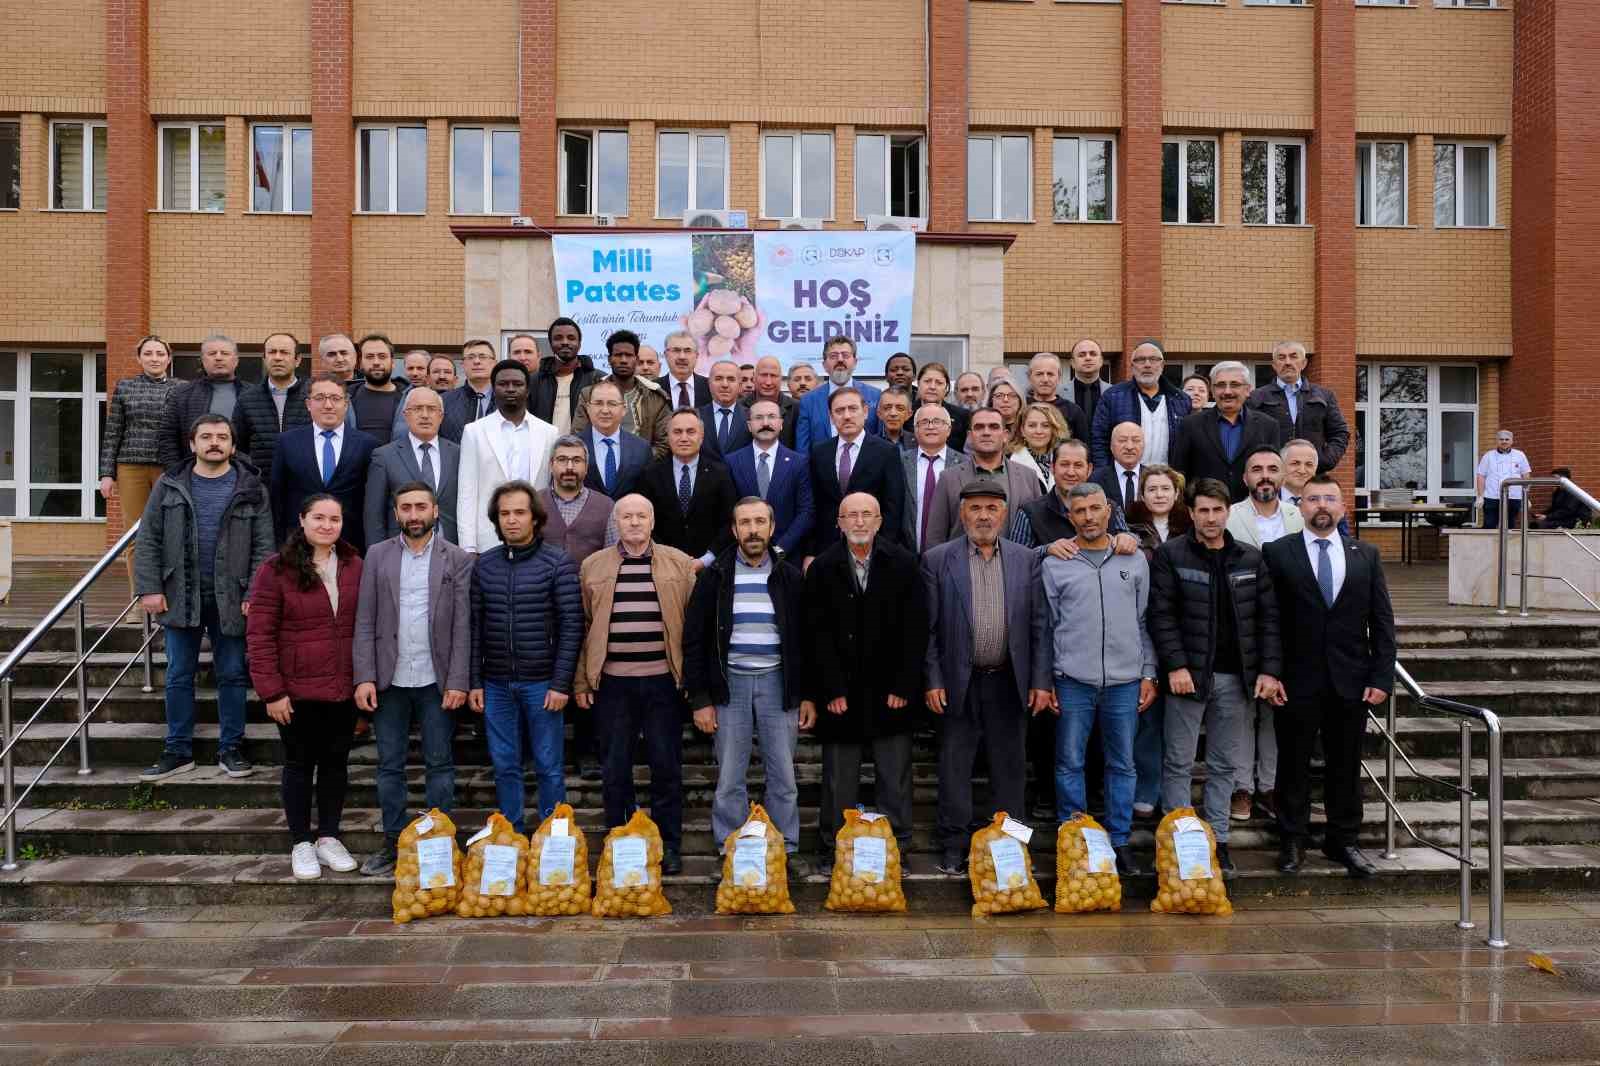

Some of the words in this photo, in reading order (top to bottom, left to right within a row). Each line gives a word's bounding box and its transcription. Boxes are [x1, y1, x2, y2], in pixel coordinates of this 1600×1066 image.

[592, 248, 652, 273] Milli
[566, 279, 681, 303] Patates
[793, 278, 872, 317] HOŞ
[767, 313, 899, 343] GELDİNİZ
